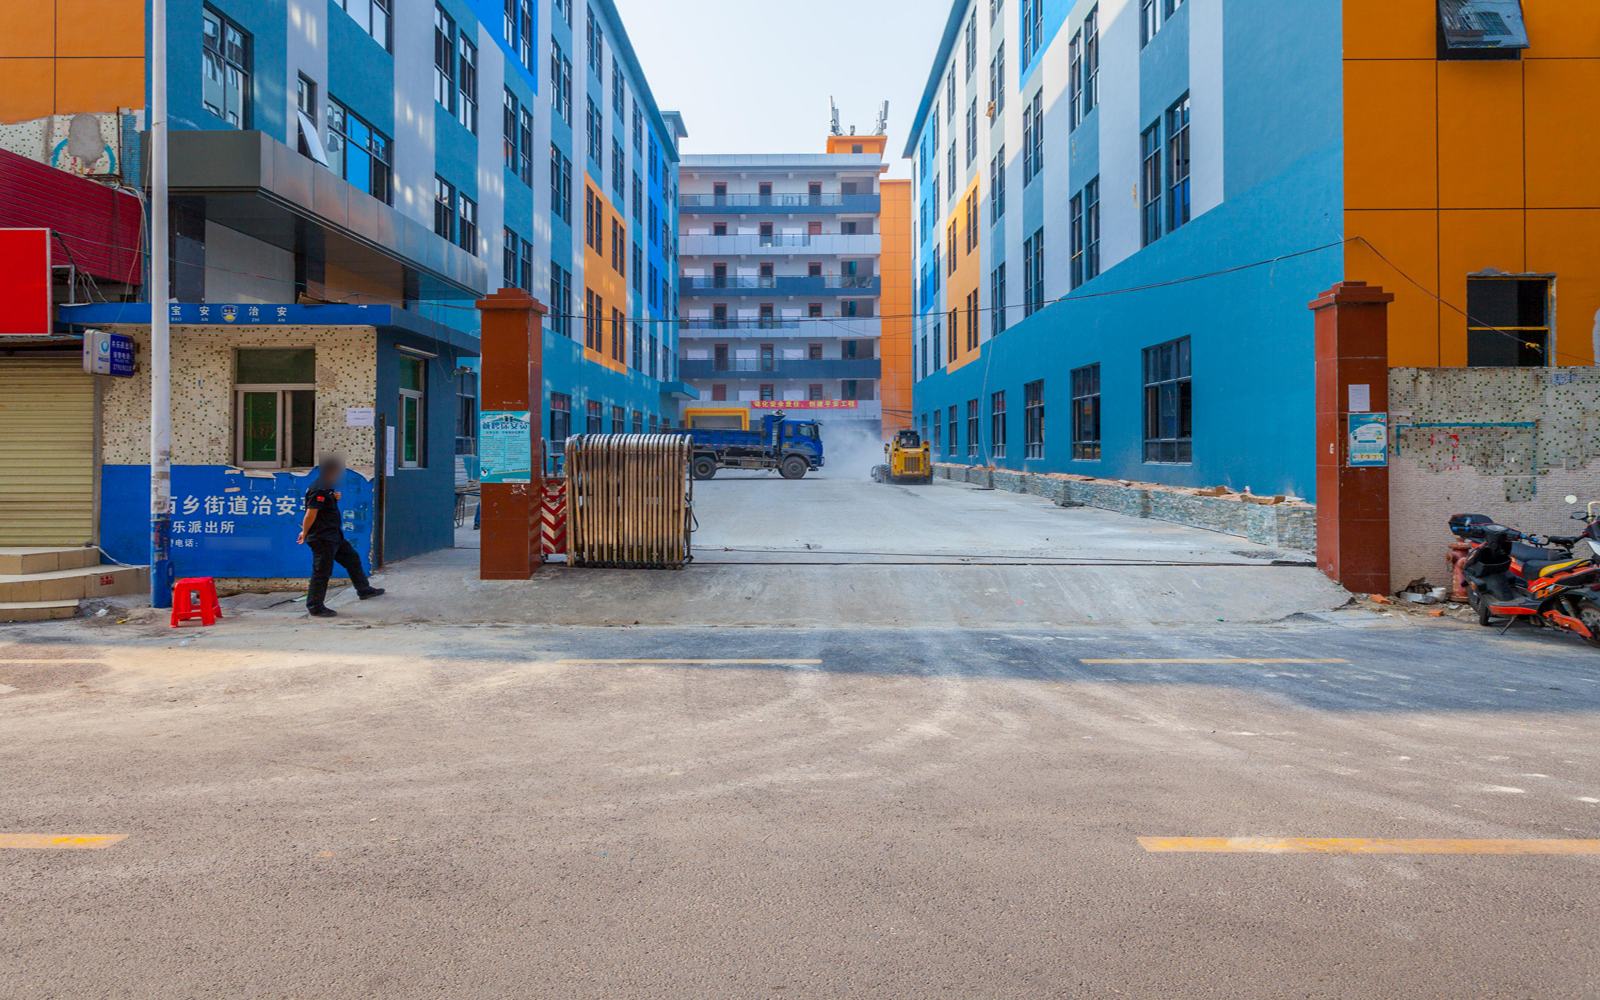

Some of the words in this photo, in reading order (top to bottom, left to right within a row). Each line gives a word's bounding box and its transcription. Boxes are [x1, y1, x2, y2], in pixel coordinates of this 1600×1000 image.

[170, 495, 307, 516] 乡街道治安
